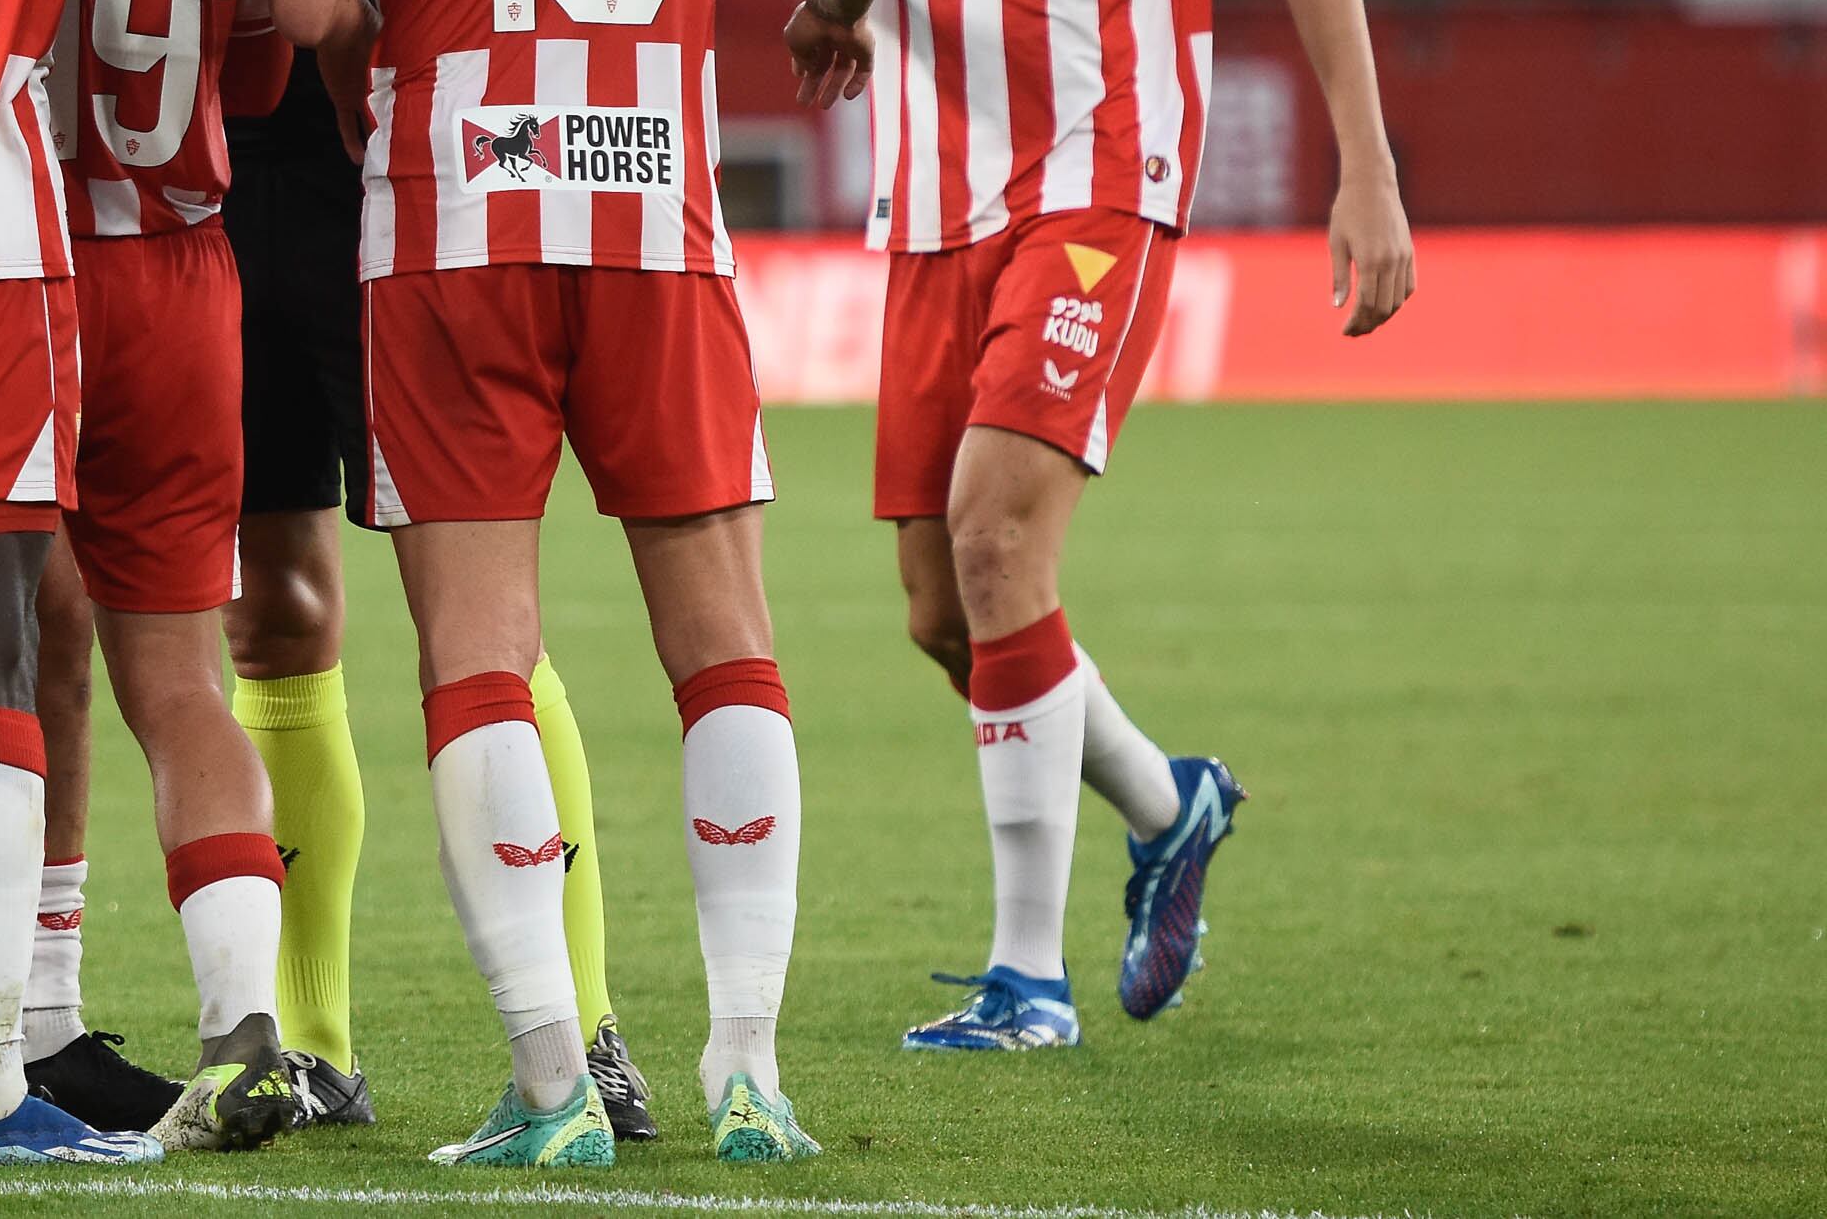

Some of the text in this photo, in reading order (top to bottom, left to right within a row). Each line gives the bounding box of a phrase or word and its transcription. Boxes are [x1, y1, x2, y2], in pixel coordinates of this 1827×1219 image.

[565, 114, 671, 150] POWER
[567, 149, 672, 185] HORSE
[1042, 315, 1100, 359] KUDU
